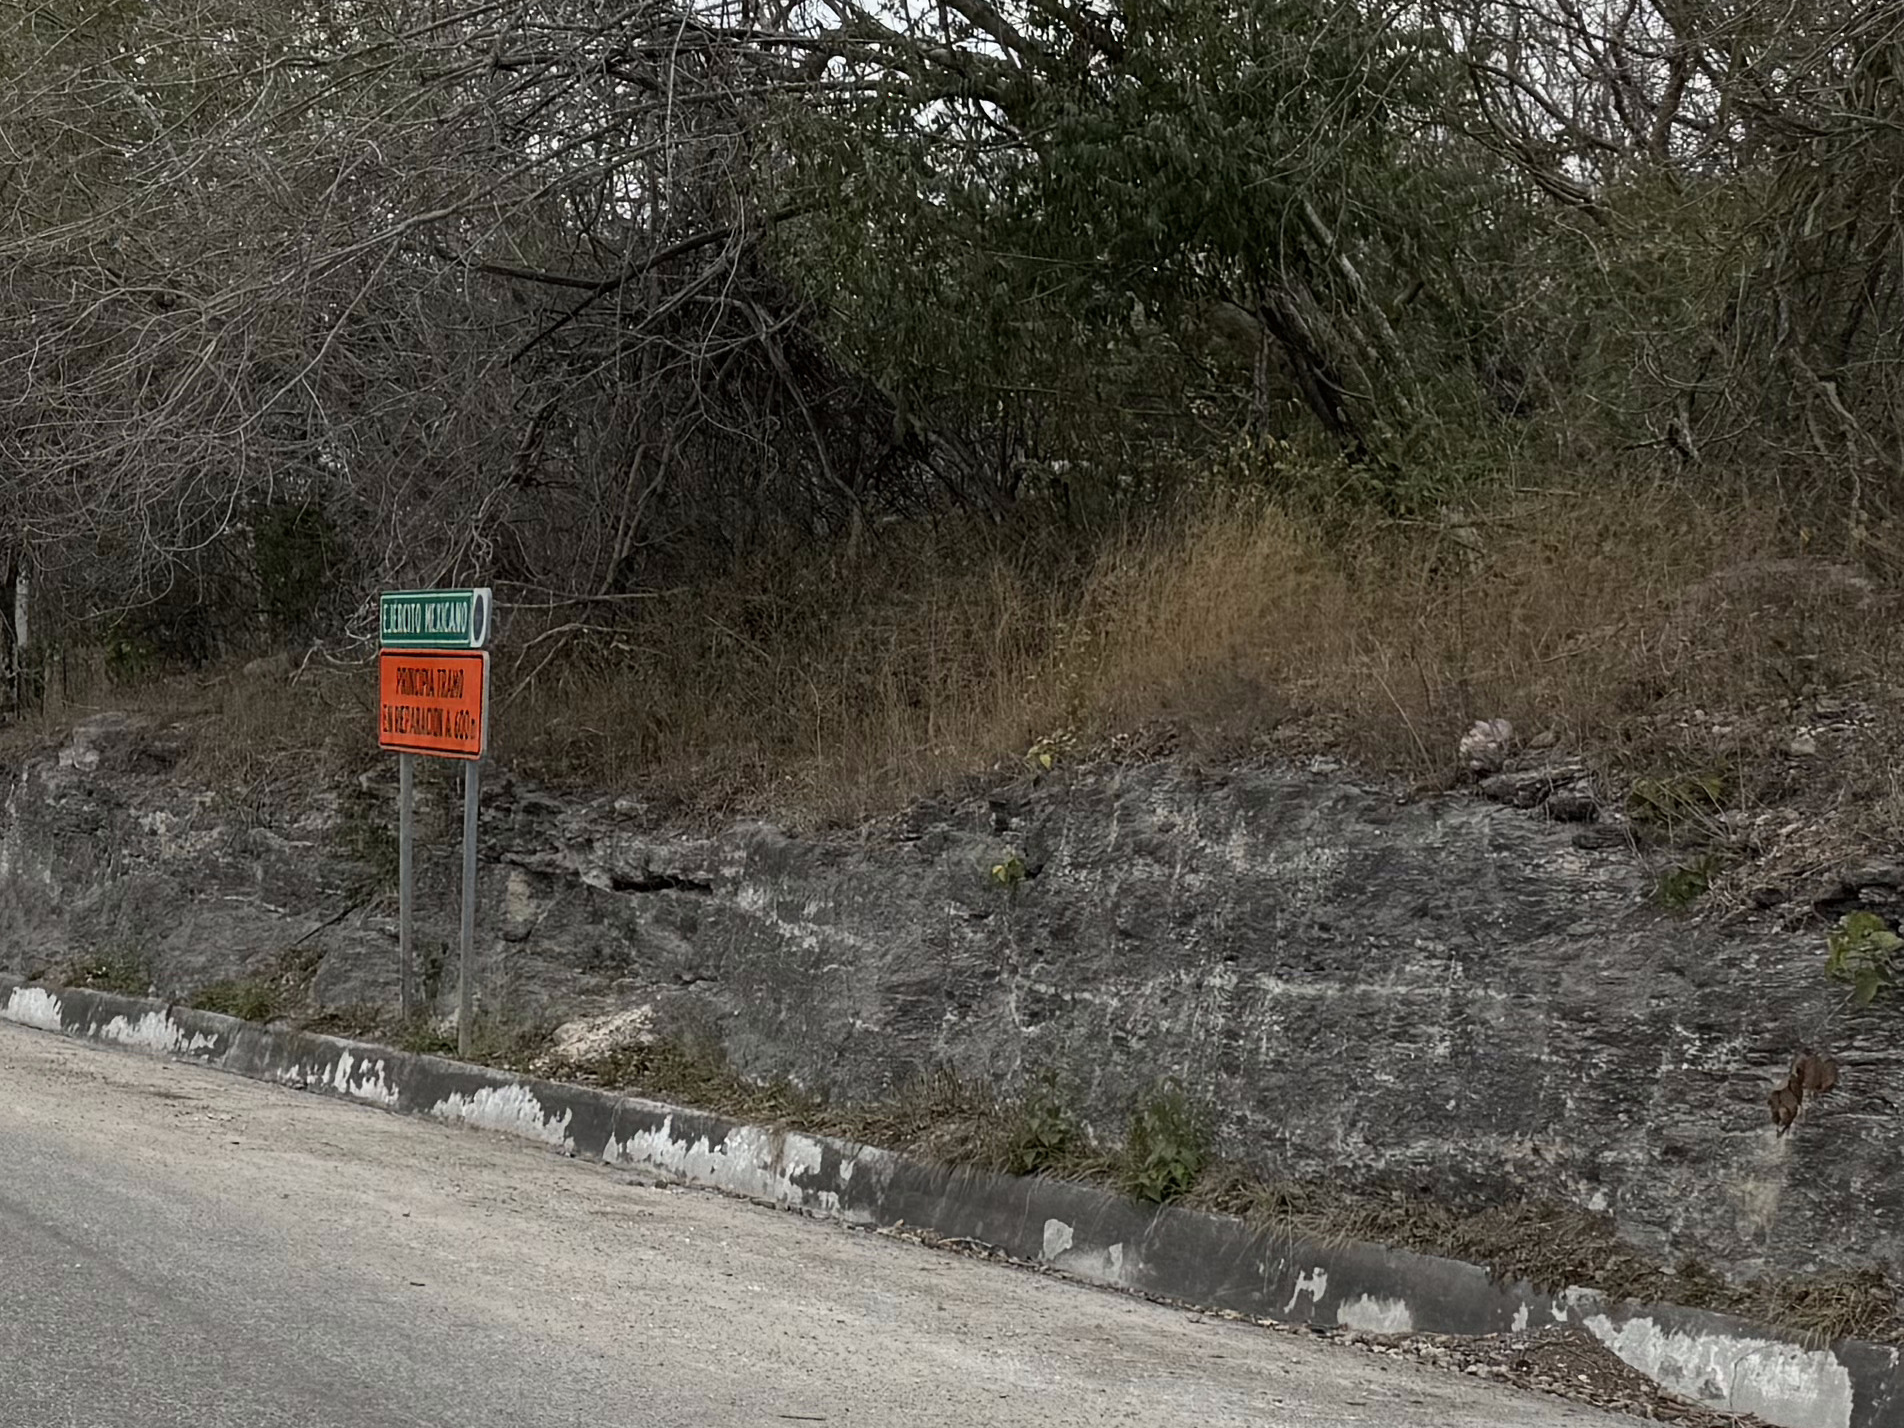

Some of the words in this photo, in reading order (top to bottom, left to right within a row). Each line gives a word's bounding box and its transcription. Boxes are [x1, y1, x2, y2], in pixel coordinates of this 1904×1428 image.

[425, 601, 467, 633] MEXICANO
[437, 669, 464, 699] TRAMO
[383, 704, 393, 732] EN
[445, 708, 452, 738] A
